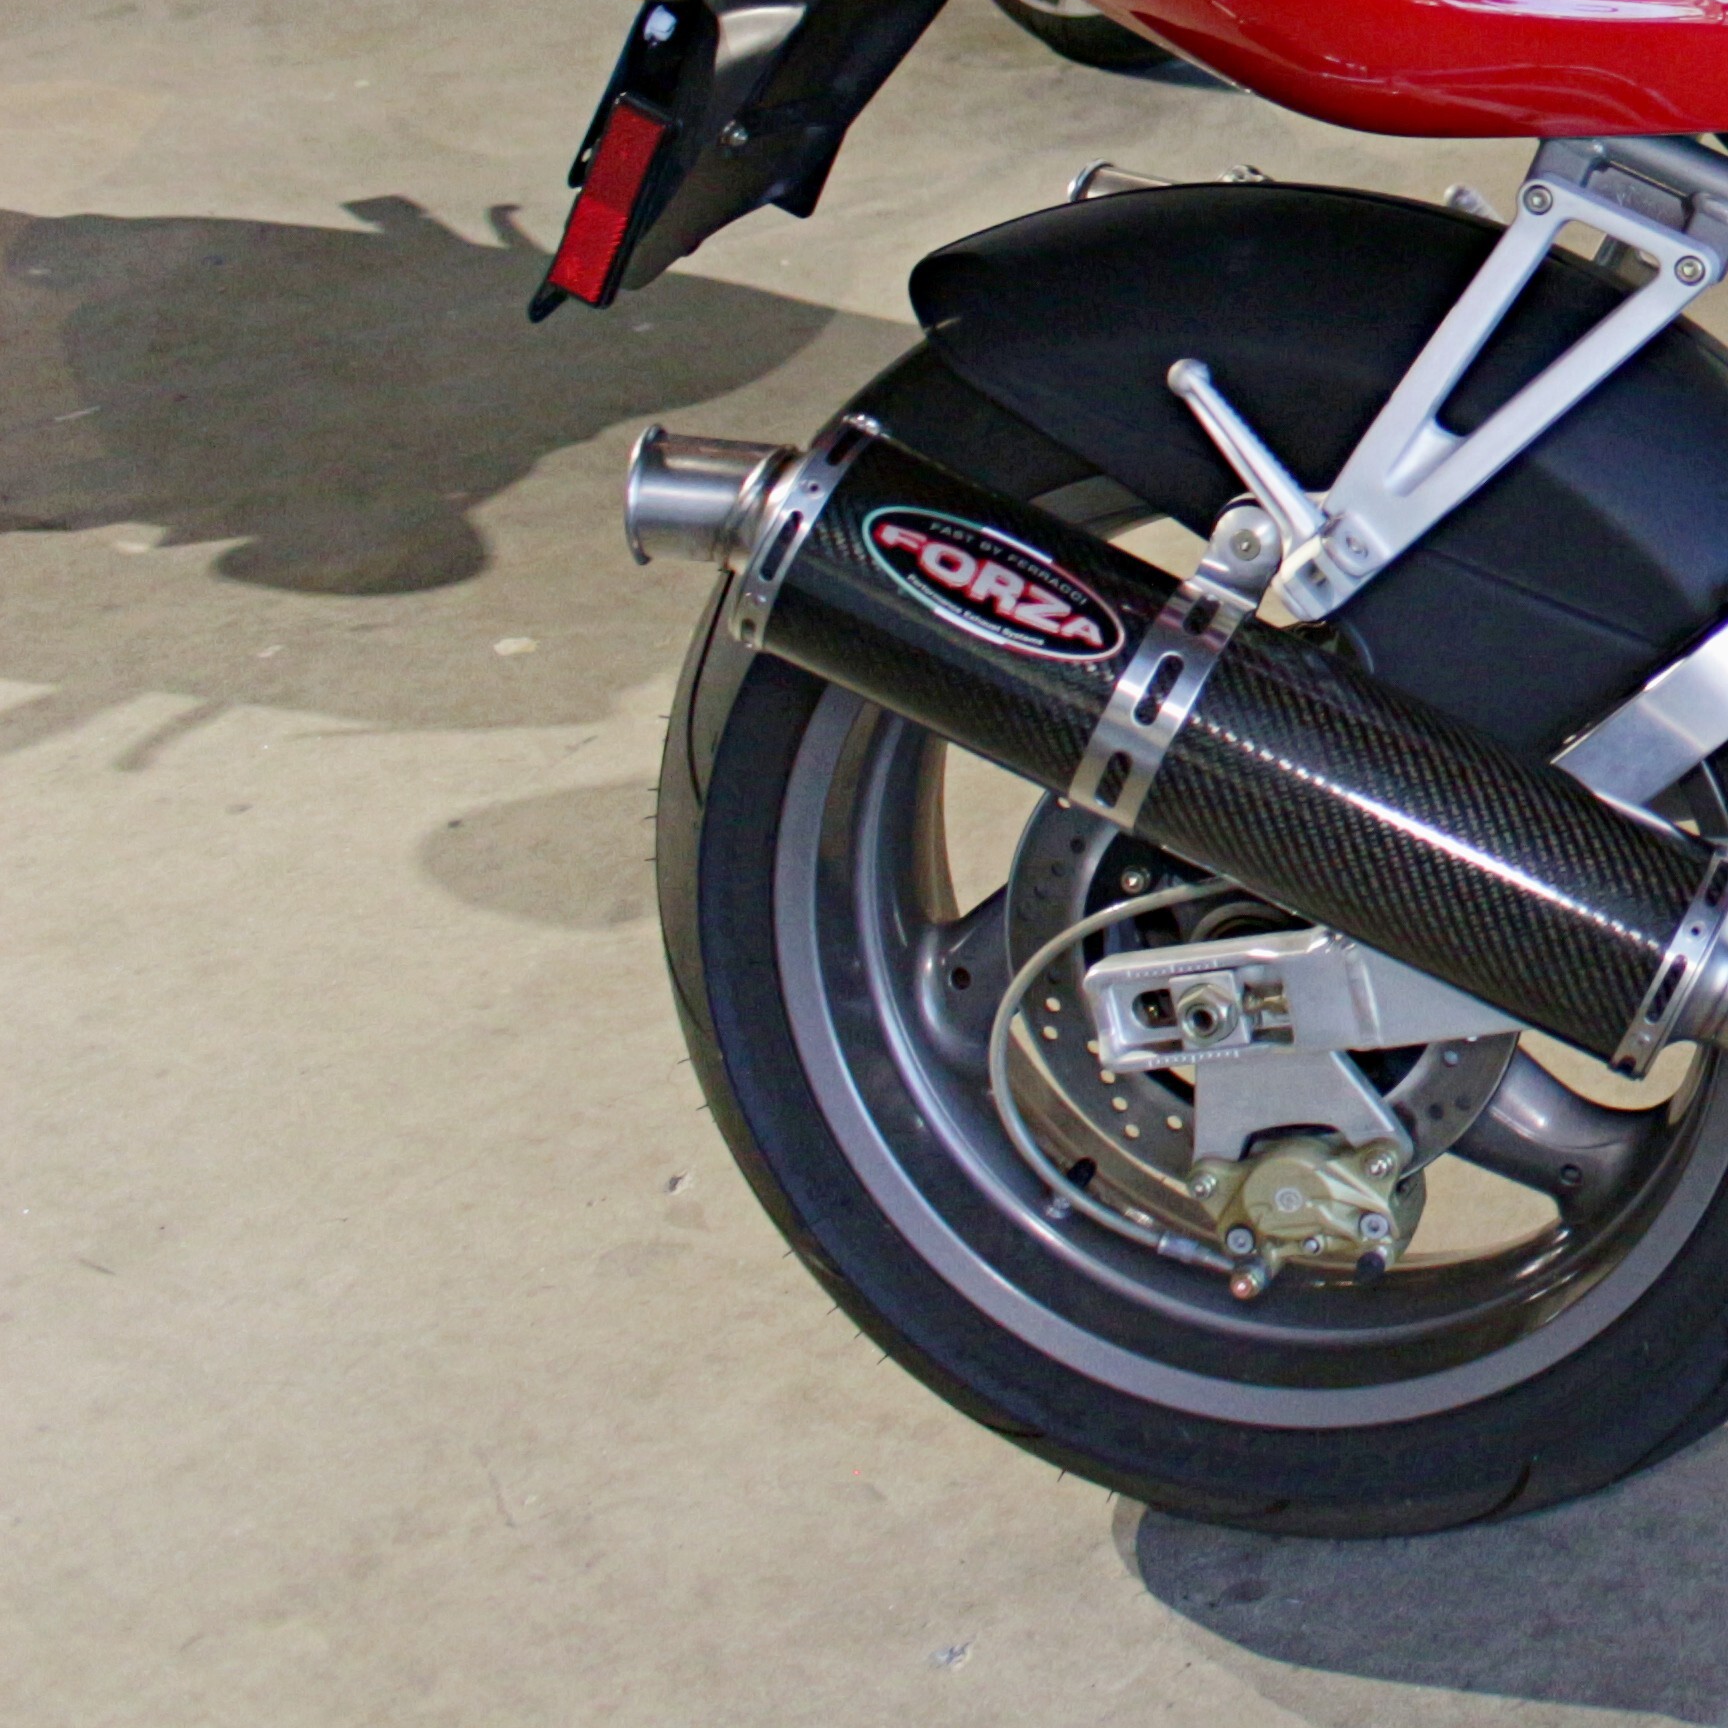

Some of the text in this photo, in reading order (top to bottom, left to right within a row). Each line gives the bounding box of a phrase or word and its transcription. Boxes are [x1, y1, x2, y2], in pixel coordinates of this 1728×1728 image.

[875, 522, 1104, 648] FORZA
[929, 522, 1089, 607] FAST BY FERRACCI
[906, 573, 1046, 646] Performance Exhaust Systems
